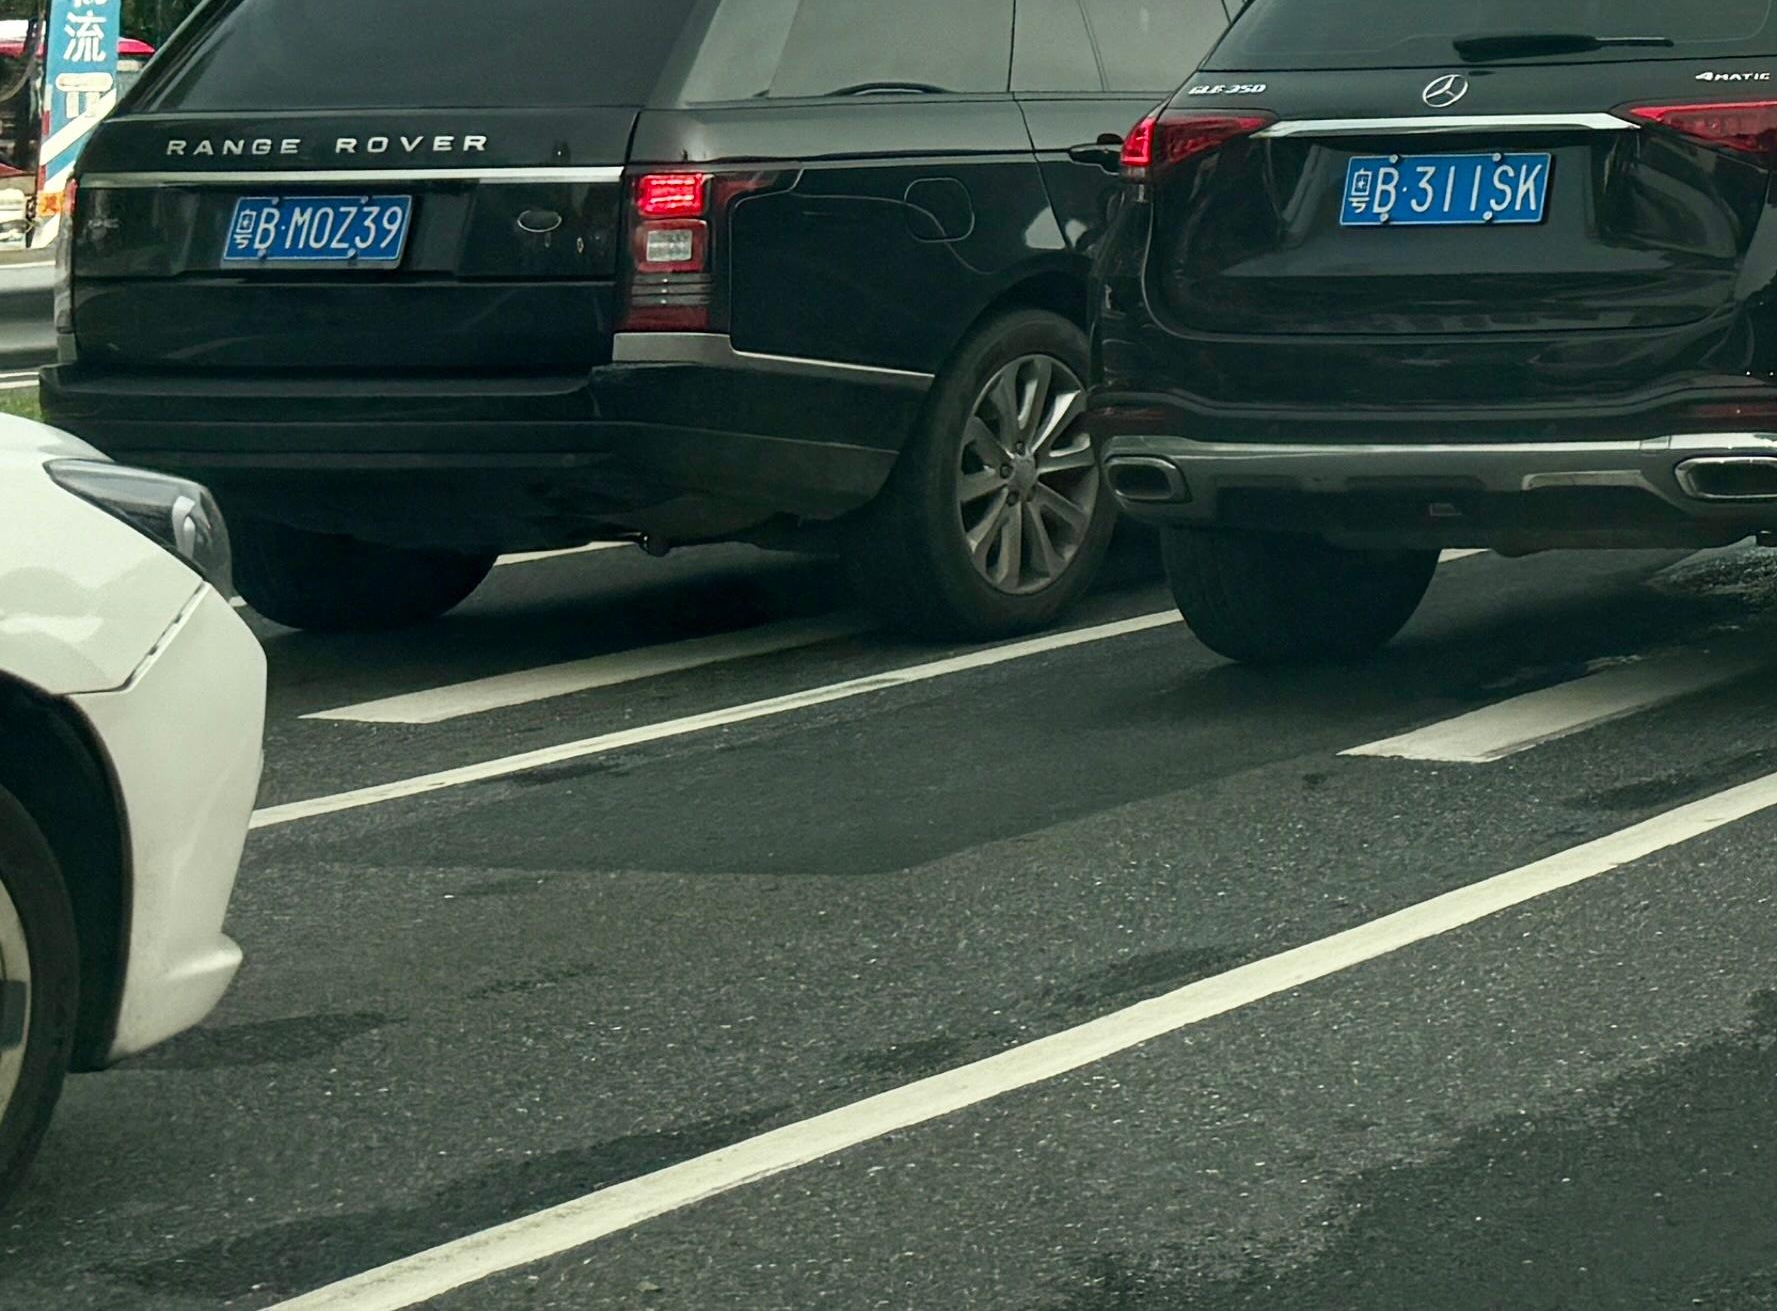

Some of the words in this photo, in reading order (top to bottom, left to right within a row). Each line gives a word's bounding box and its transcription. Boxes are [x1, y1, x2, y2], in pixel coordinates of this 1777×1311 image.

[1695, 71, 1771, 81] 4MATIC
[165, 137, 303, 157] RANGE
[334, 134, 489, 154] ROVER
